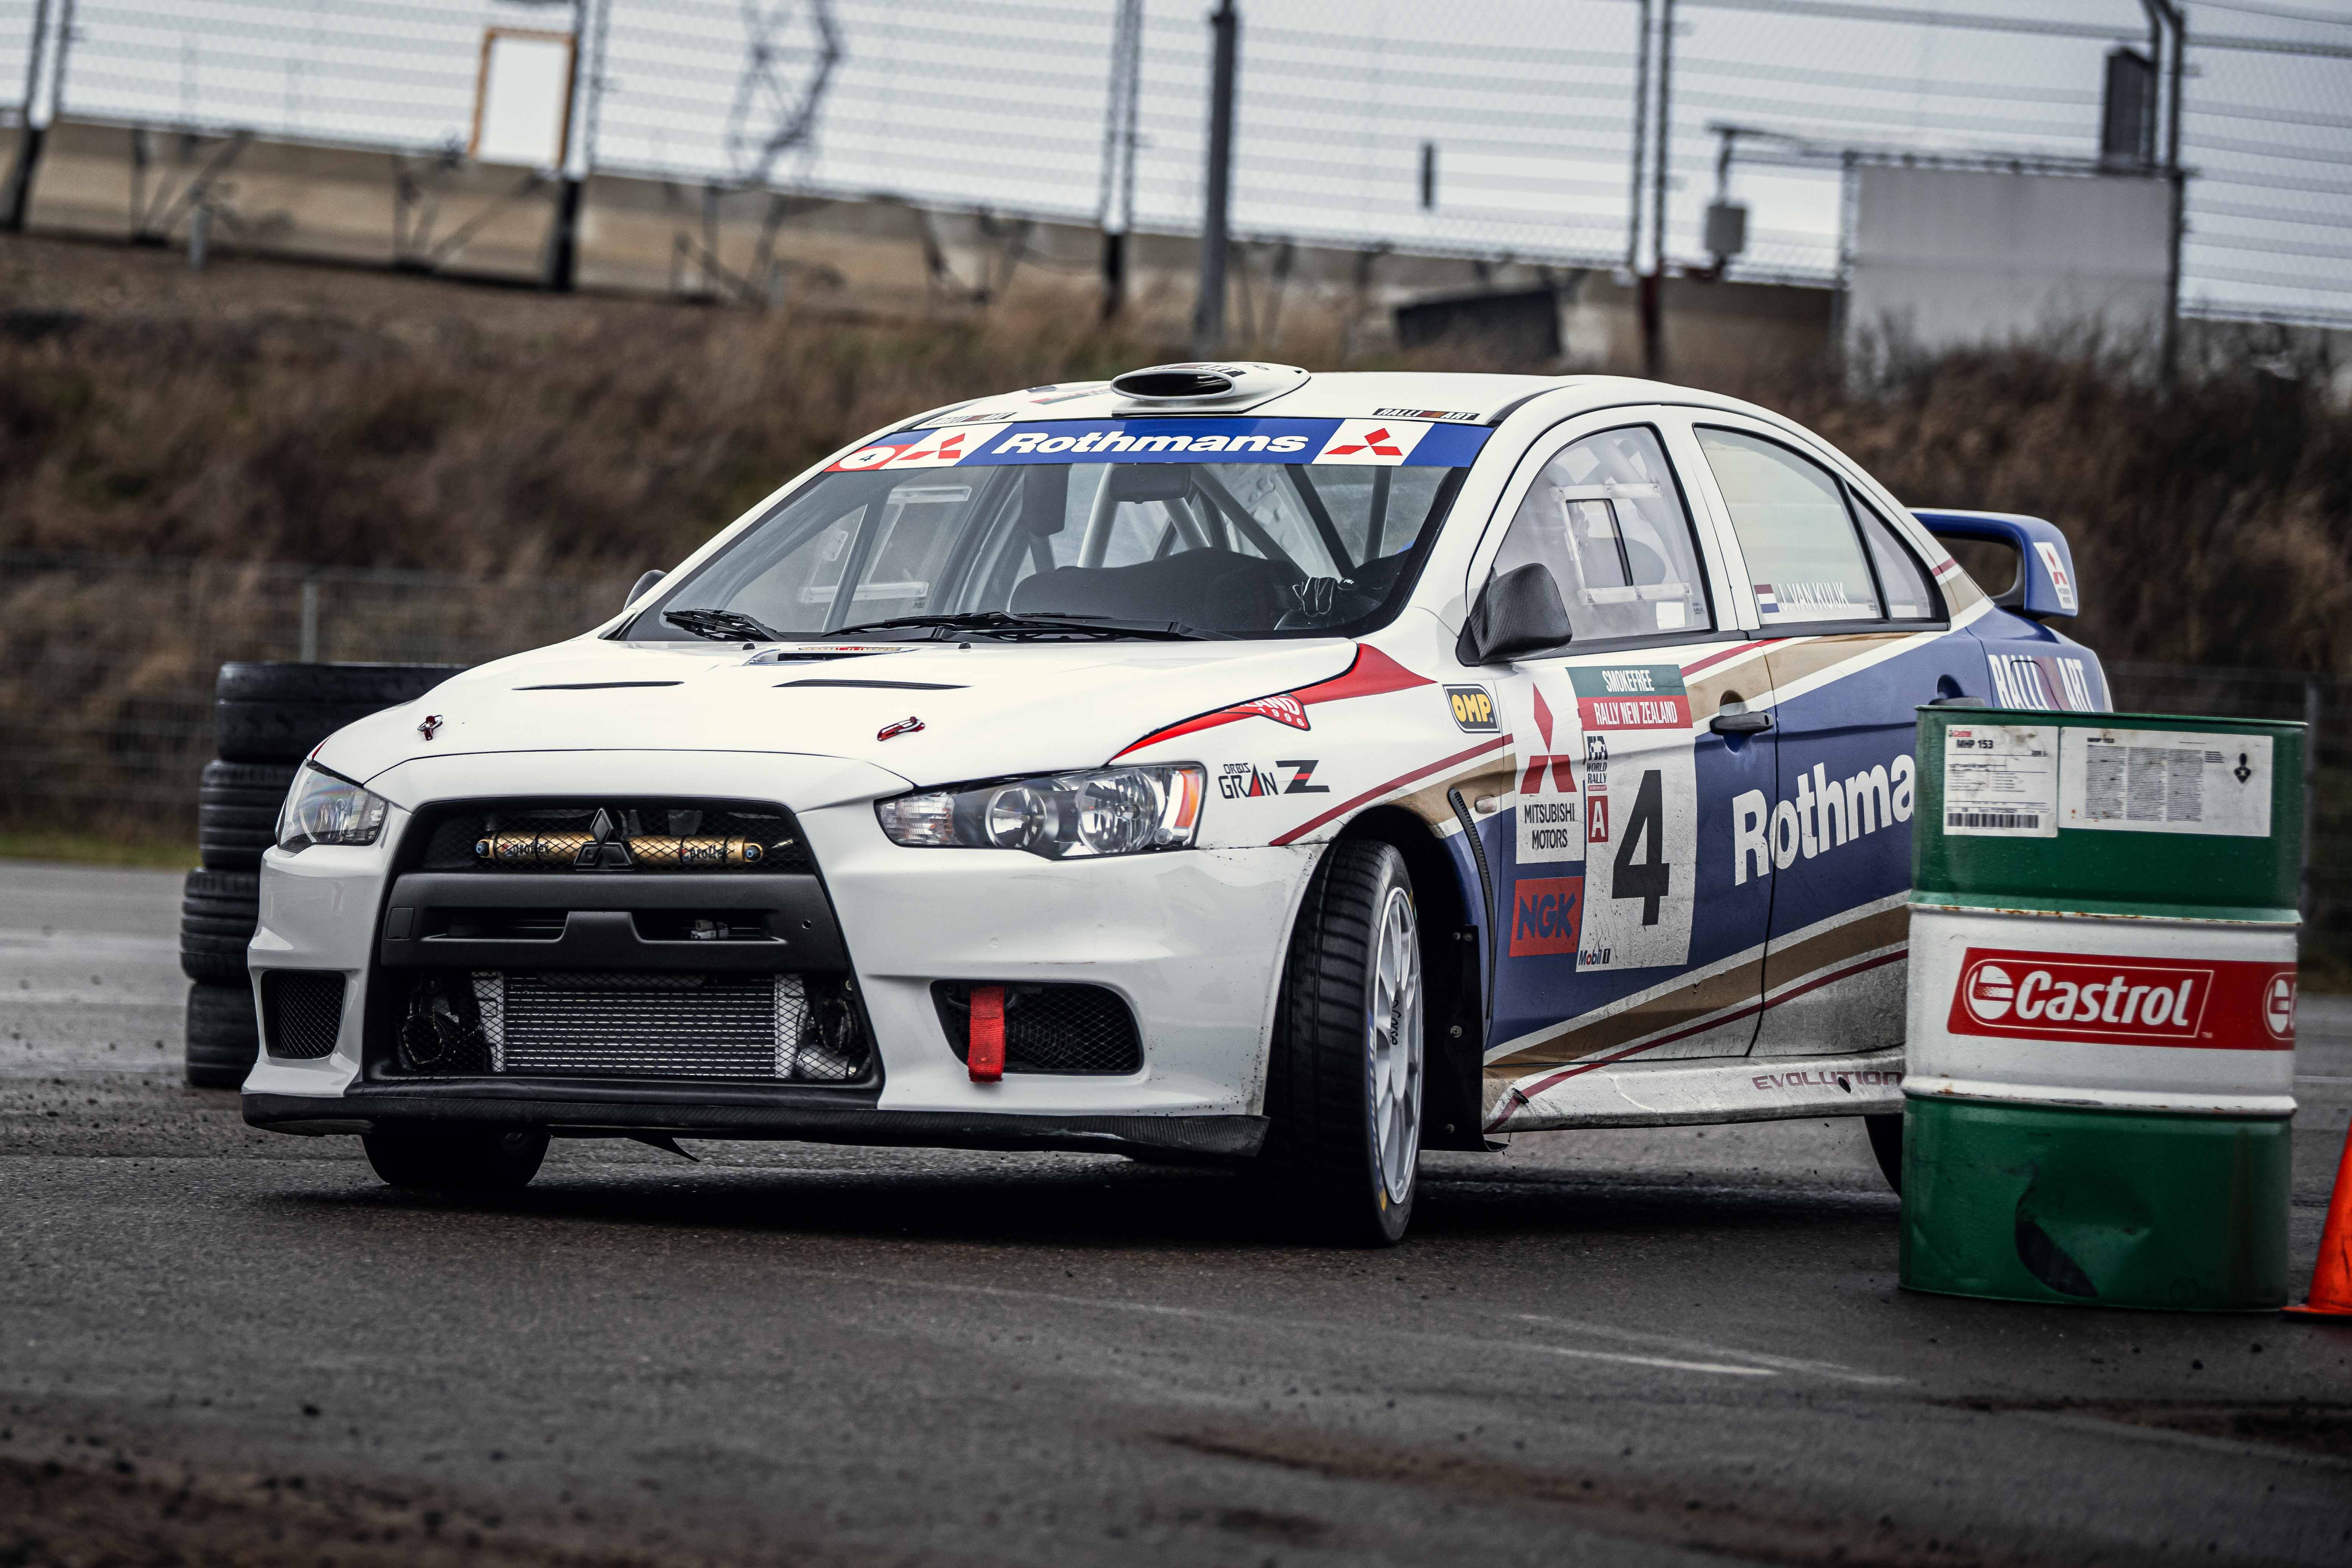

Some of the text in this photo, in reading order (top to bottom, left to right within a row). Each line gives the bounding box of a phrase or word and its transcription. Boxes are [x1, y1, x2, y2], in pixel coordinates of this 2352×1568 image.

[991, 431, 1309, 454] Rothmans
[859, 454, 876, 462] 4
[1786, 582, 1817, 612] VAN
[1602, 669, 1655, 692] SMOKEFREE
[1988, 655, 2095, 712] RALLI ART
[1257, 707, 1305, 726] 1996
[1451, 694, 1491, 722] OMP
[1593, 701, 1678, 725] RALLY NEW ZEALAND
[1978, 740, 1993, 749] 153
[1223, 762, 1251, 775] ORBIS
[1587, 762, 1607, 772] WORLD
[1588, 773, 1607, 784] RALLY
[1218, 760, 1330, 799] GRAN Z
[1524, 803, 1574, 823] MITSUBISHI
[1591, 801, 1605, 837] A
[1532, 829, 1568, 849] MOTORS
[1612, 770, 1670, 926] 4
[1517, 892, 1577, 941] NGK
[1578, 948, 1611, 966] Mobil 1
[2015, 970, 2193, 1027] Castrol
